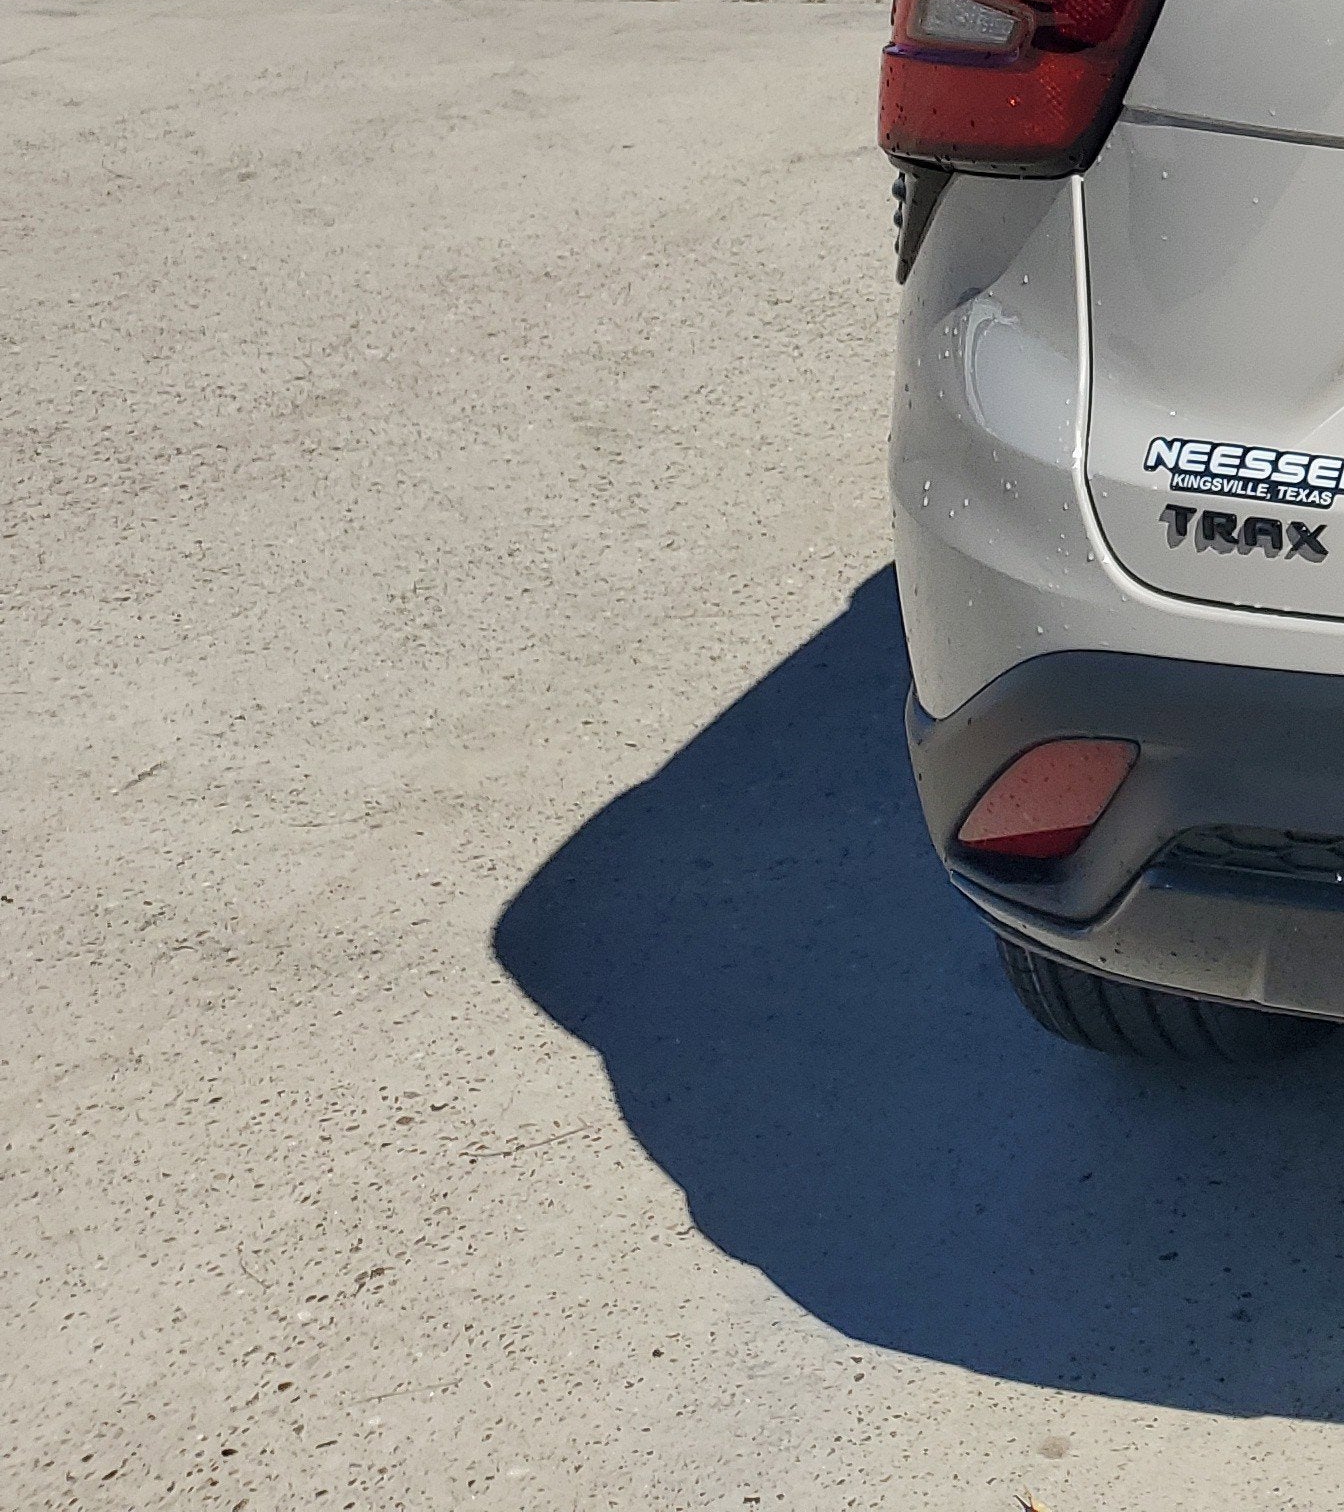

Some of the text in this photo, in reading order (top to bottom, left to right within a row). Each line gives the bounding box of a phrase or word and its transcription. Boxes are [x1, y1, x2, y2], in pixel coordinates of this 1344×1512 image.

[1172, 473, 1333, 506] KINGSVILLE, TEXAS
[1160, 504, 1329, 557] TRAX
